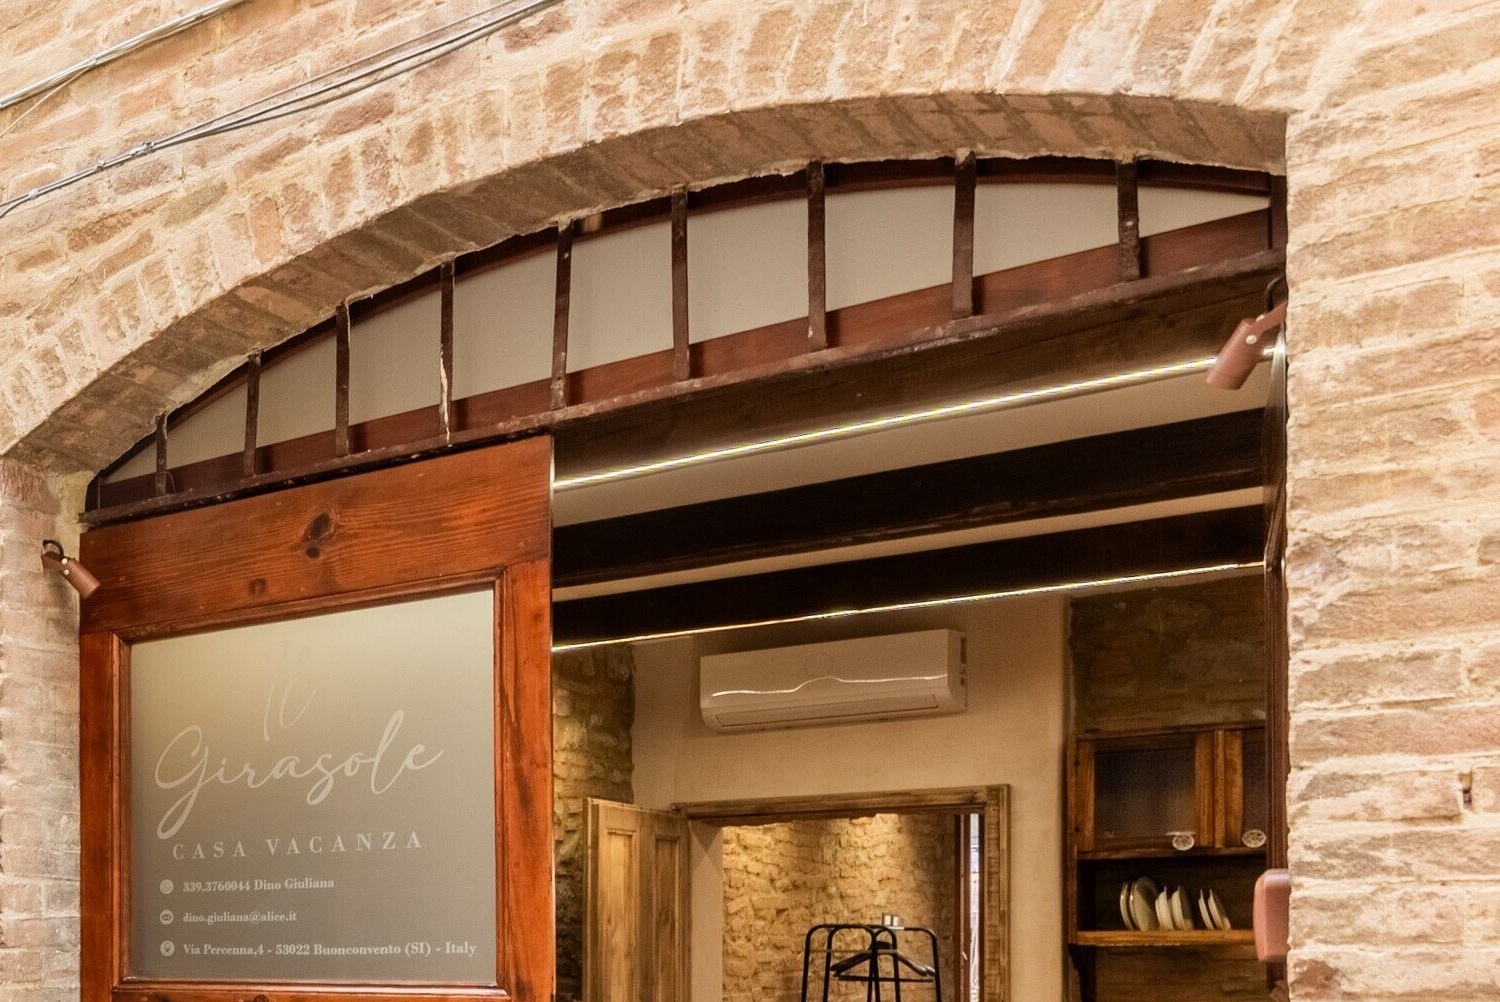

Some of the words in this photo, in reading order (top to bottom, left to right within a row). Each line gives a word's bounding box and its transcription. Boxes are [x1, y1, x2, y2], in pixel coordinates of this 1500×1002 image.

[154, 709, 445, 840] Girasole
[172, 841, 246, 860] CASA
[265, 830, 422, 855] VACANZA
[182, 880, 250, 892] 339.3760044
[254, 879, 281, 891] Dino
[285, 877, 335, 890] Giuliana
[183, 911, 297, 924] dino.giuliana@alice.it
[183, 943, 200, 955] Via
[275, 943, 310, 956] 53022
[313, 944, 401, 956] Buonconvento
[405, 941, 431, 957] (SI)
[445, 941, 477, 957] Italy
